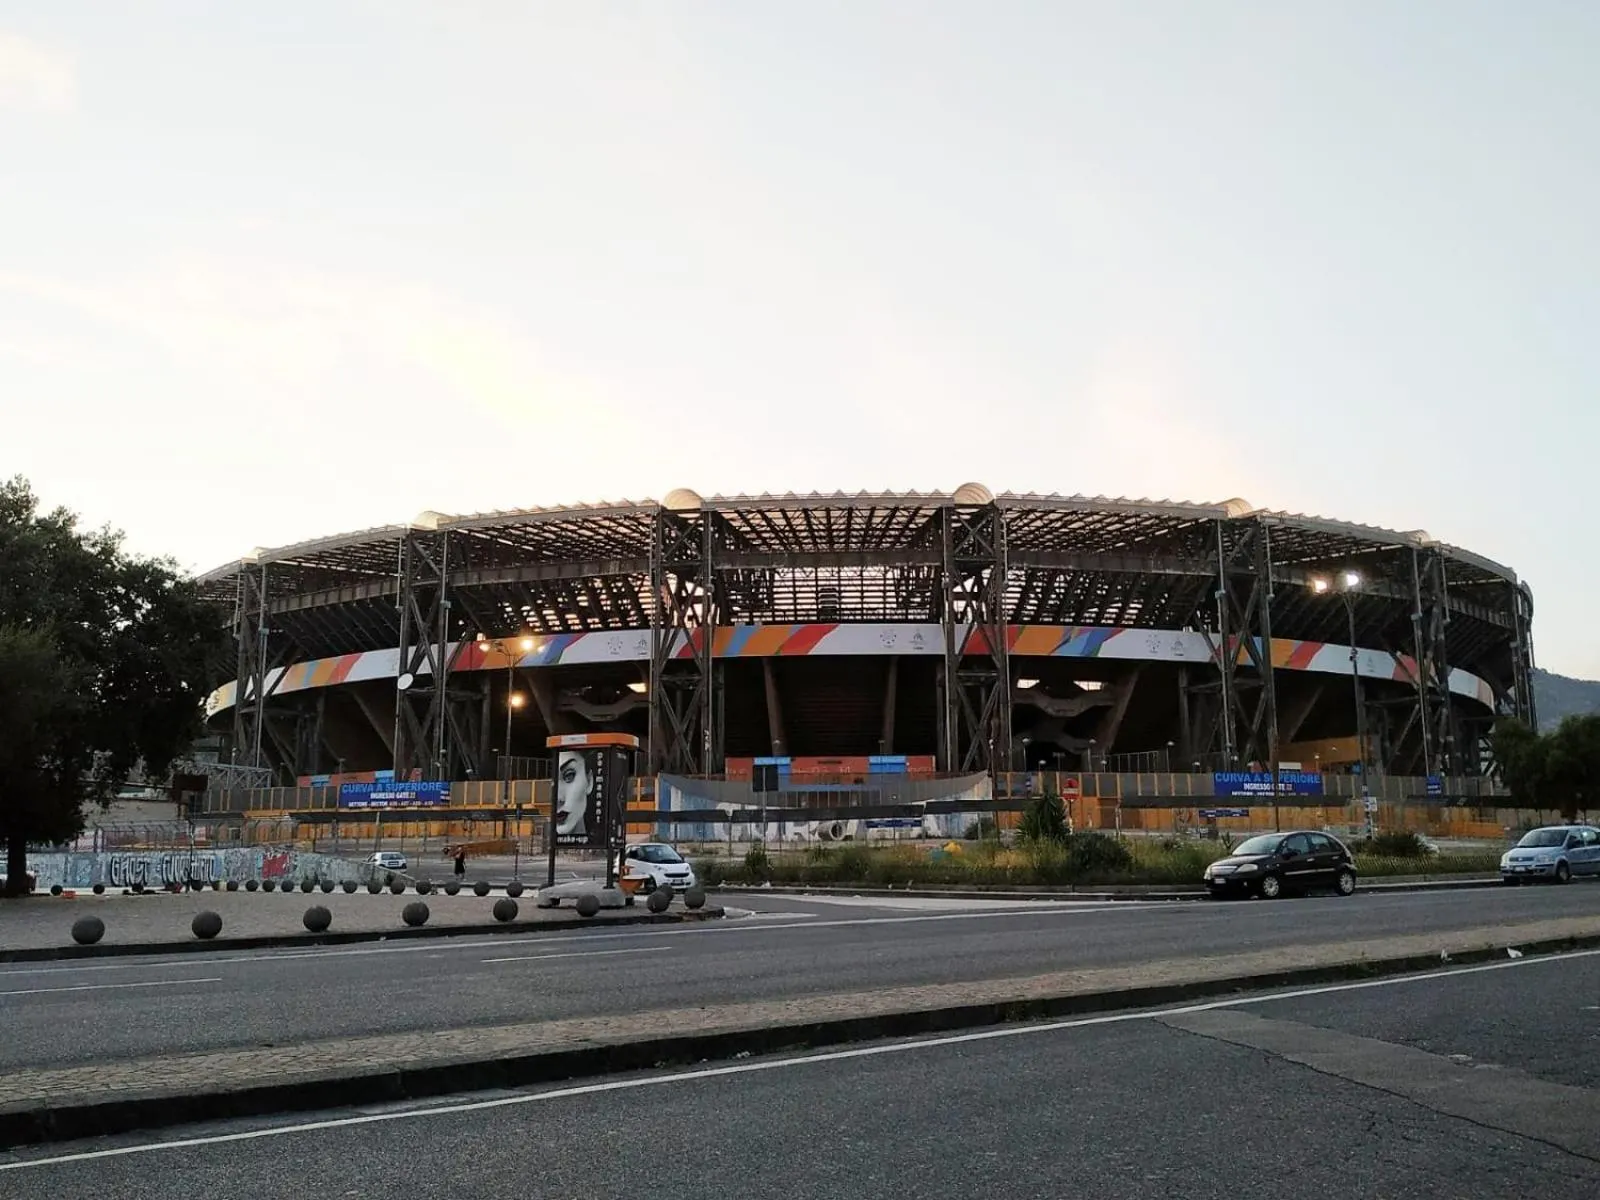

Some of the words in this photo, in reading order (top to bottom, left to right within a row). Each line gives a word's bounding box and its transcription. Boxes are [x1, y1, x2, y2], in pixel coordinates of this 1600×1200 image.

[1214, 773, 1251, 783] CURVA
[1254, 773, 1262, 782] A
[342, 783, 374, 793] CURVA
[375, 783, 384, 792] A
[385, 782, 442, 792] SUPERIORE
[595, 752, 604, 824] permanent
[557, 836, 588, 844] make-up
